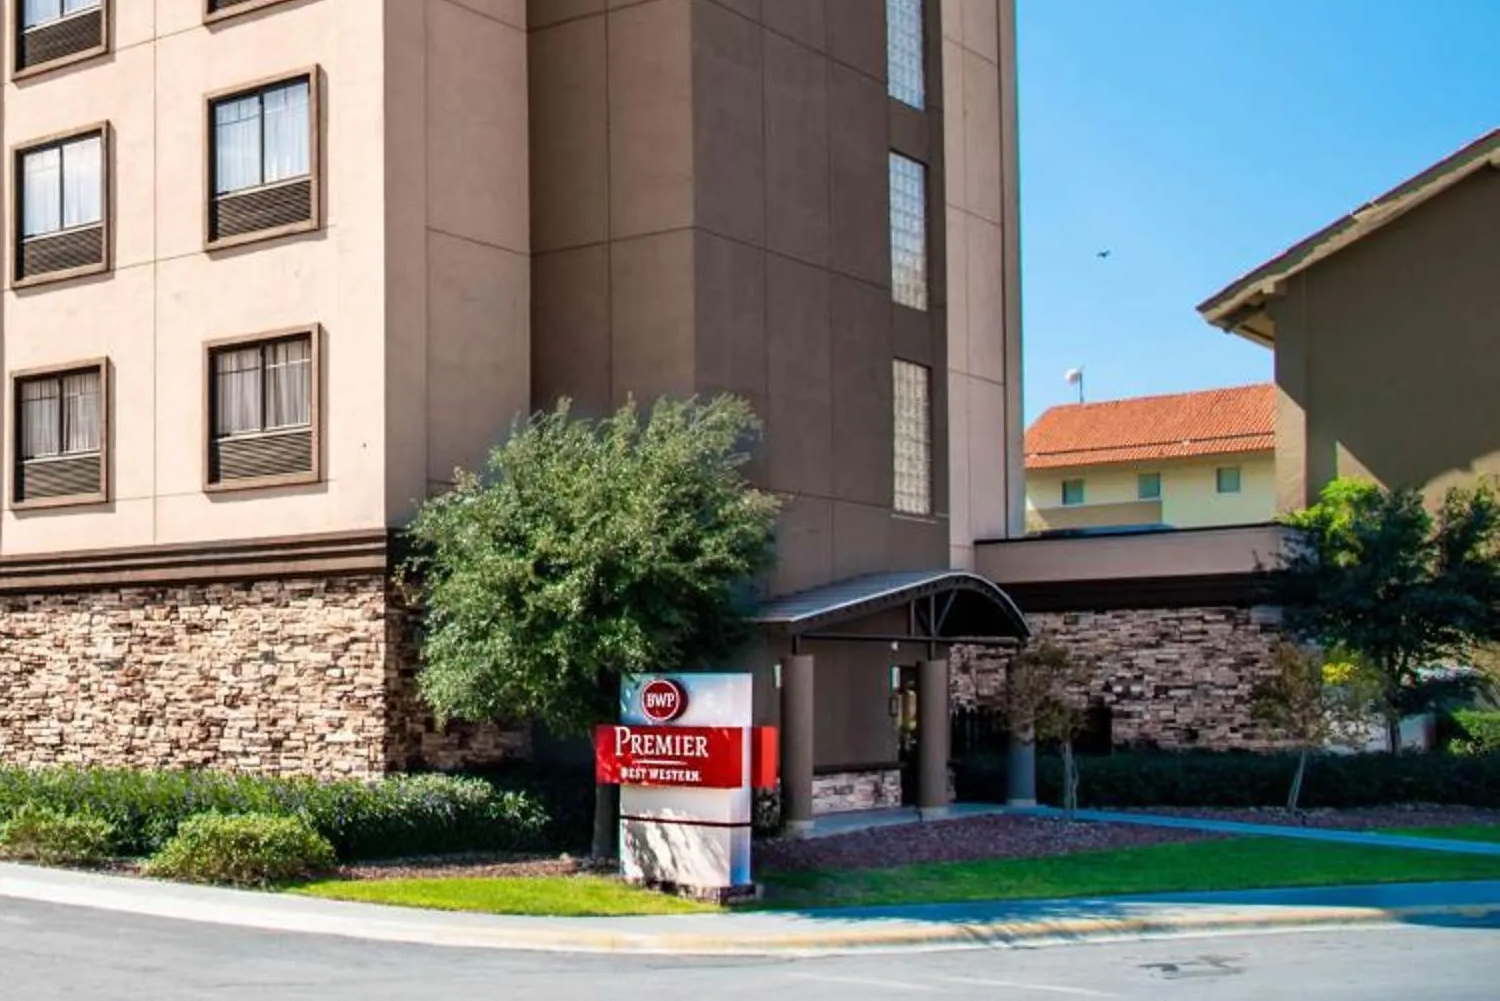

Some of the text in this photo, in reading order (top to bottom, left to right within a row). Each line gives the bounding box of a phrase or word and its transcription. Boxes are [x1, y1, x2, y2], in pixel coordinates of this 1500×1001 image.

[646, 692, 675, 708] BWP
[614, 726, 709, 758] PREMIER
[620, 767, 700, 783] BEST WESTERN
